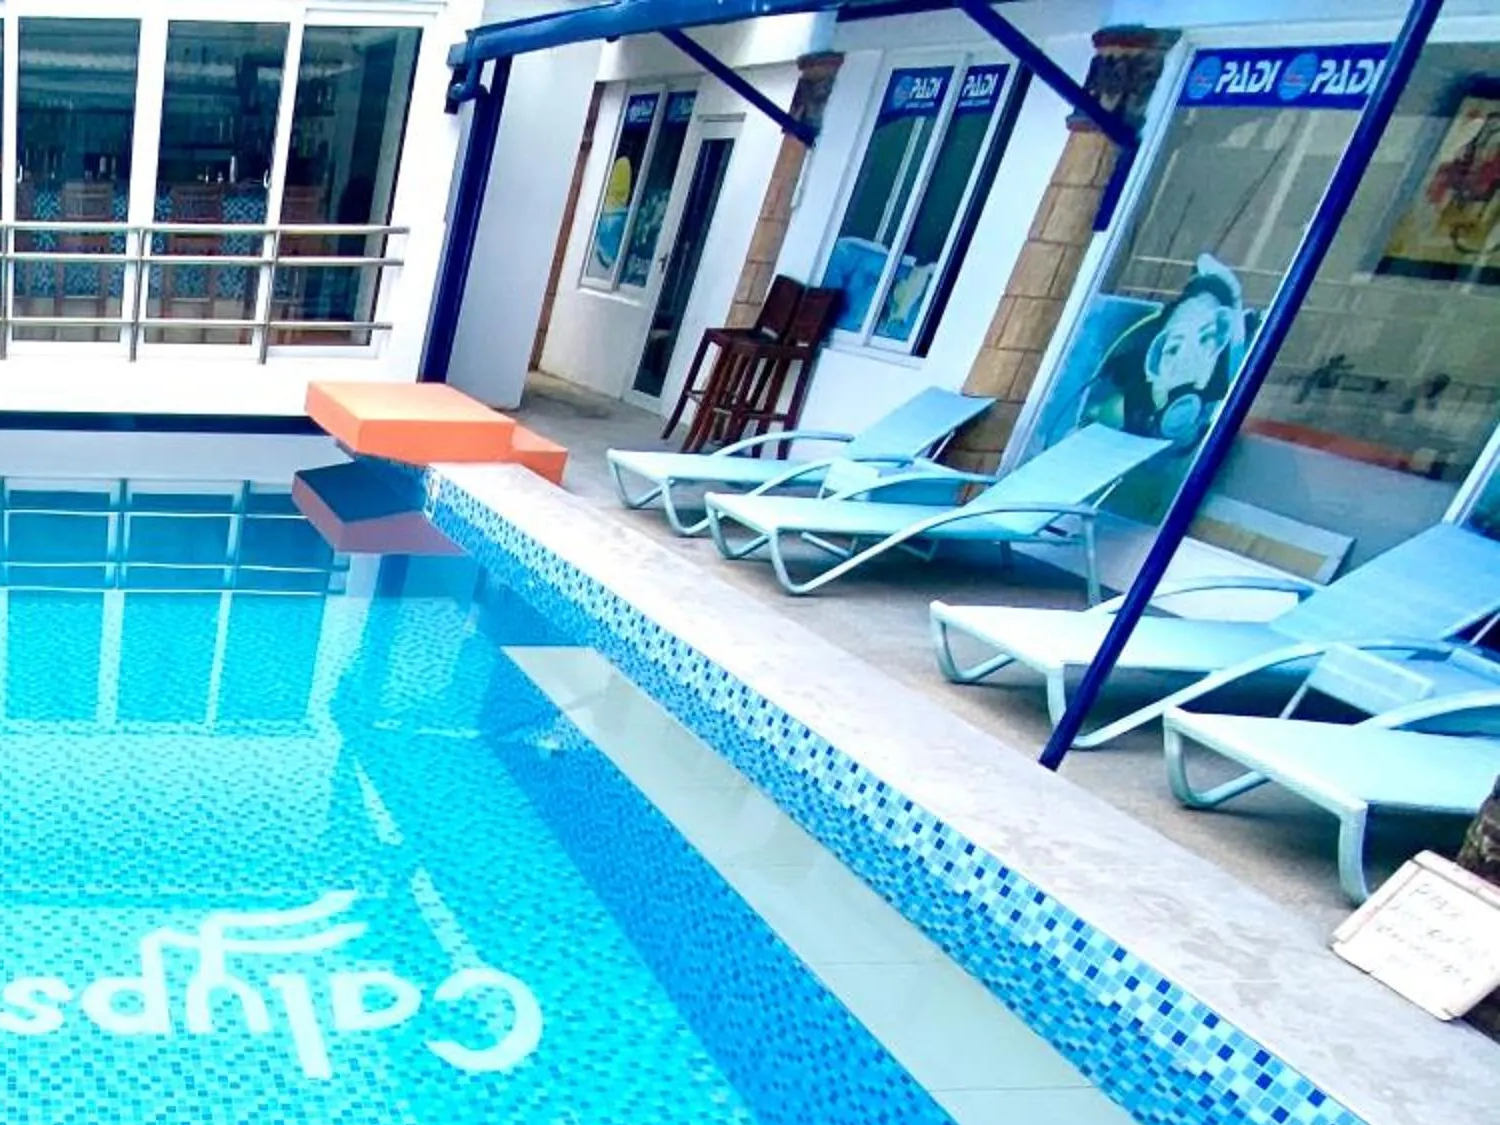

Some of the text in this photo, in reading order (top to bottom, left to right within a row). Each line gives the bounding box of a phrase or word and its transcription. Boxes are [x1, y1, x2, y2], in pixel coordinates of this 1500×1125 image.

[909, 77, 943, 99] PADI
[961, 73, 999, 97] PADI
[1215, 59, 1386, 95] PADI PADI
